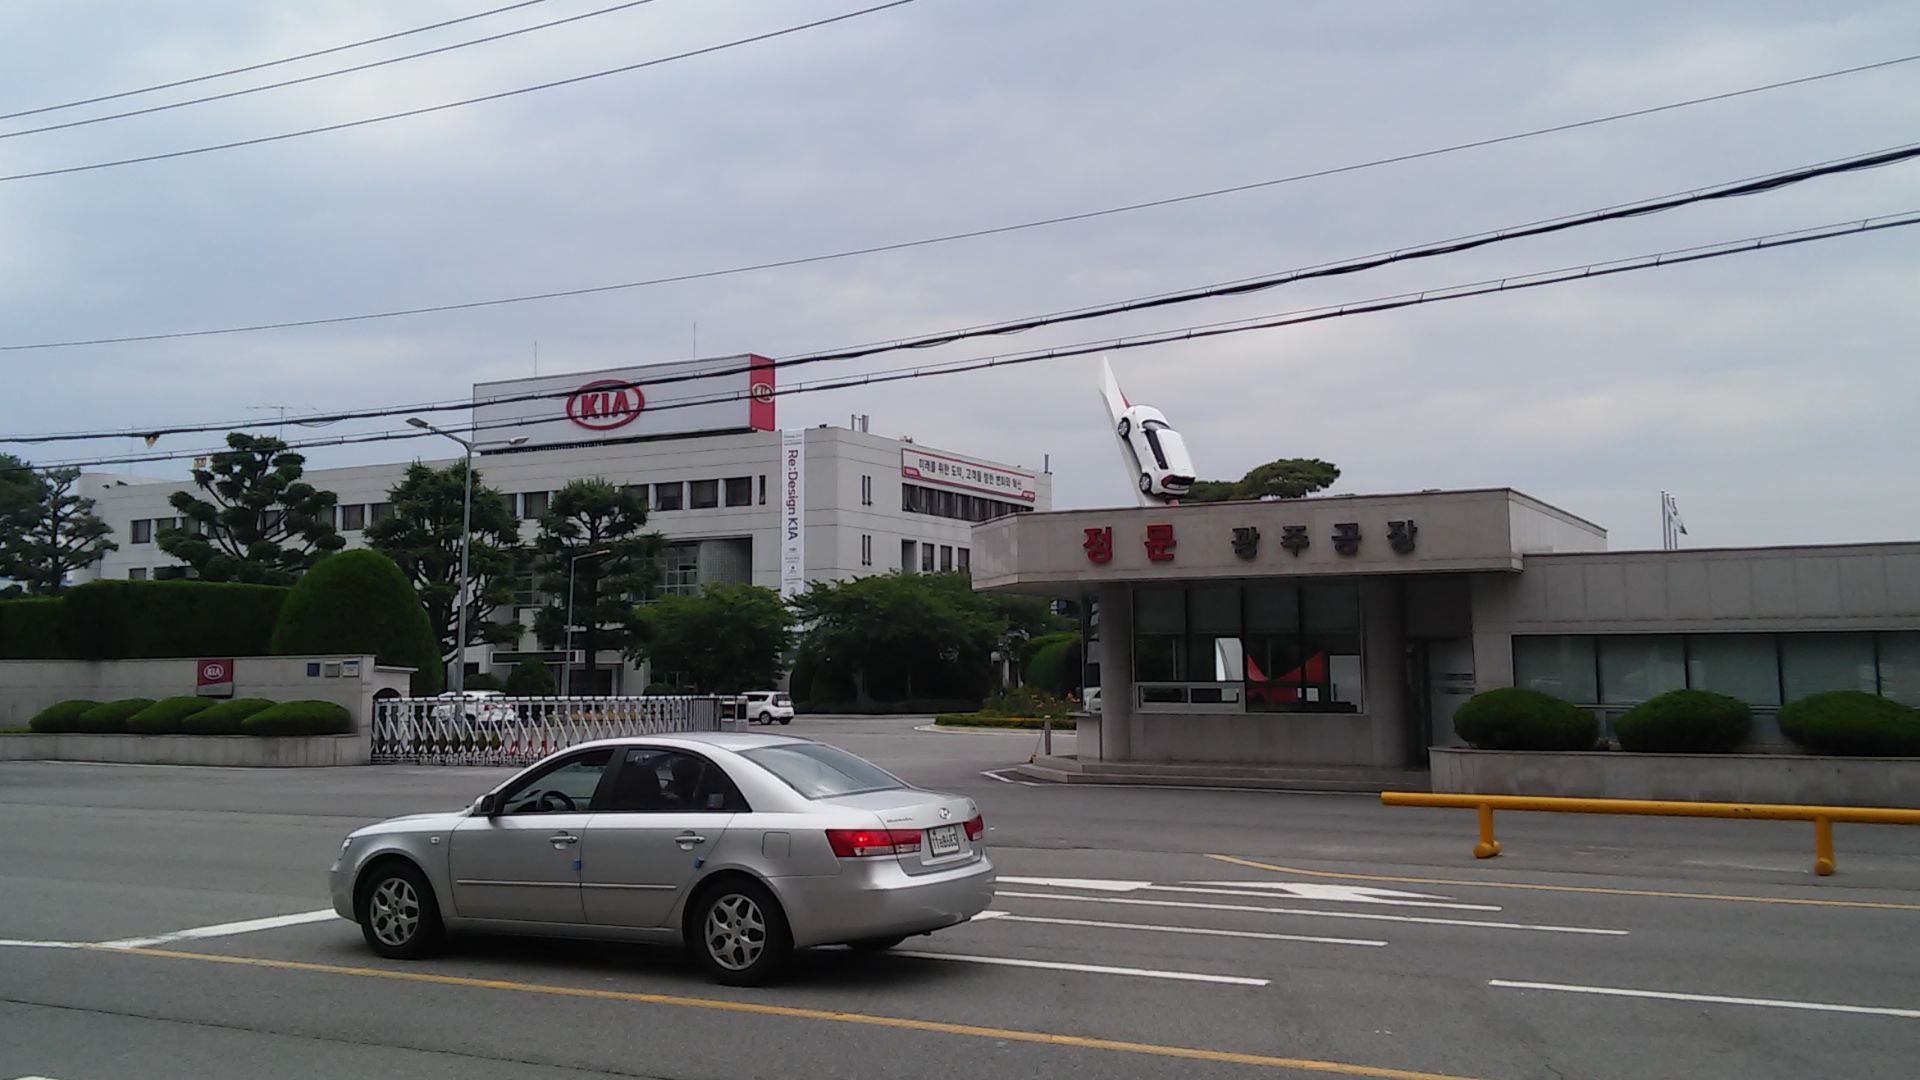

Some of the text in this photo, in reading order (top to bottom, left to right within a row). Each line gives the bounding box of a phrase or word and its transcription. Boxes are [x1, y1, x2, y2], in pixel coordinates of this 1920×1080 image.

[581, 391, 631, 420] KIA
[786, 449, 799, 515] Re:Design
[919, 458, 936, 473] 미래를
[938, 462, 949, 476] 위한
[951, 465, 964, 480] 도약,
[966, 468, 982, 483] 고객을
[983, 473, 994, 486] 향한
[995, 475, 1011, 489] 변화와
[1012, 478, 1022, 491] 혁신
[788, 517, 799, 541] KIA
[1083, 519, 1418, 565] 정문 광주공장
[207, 667, 221, 676] KIA
